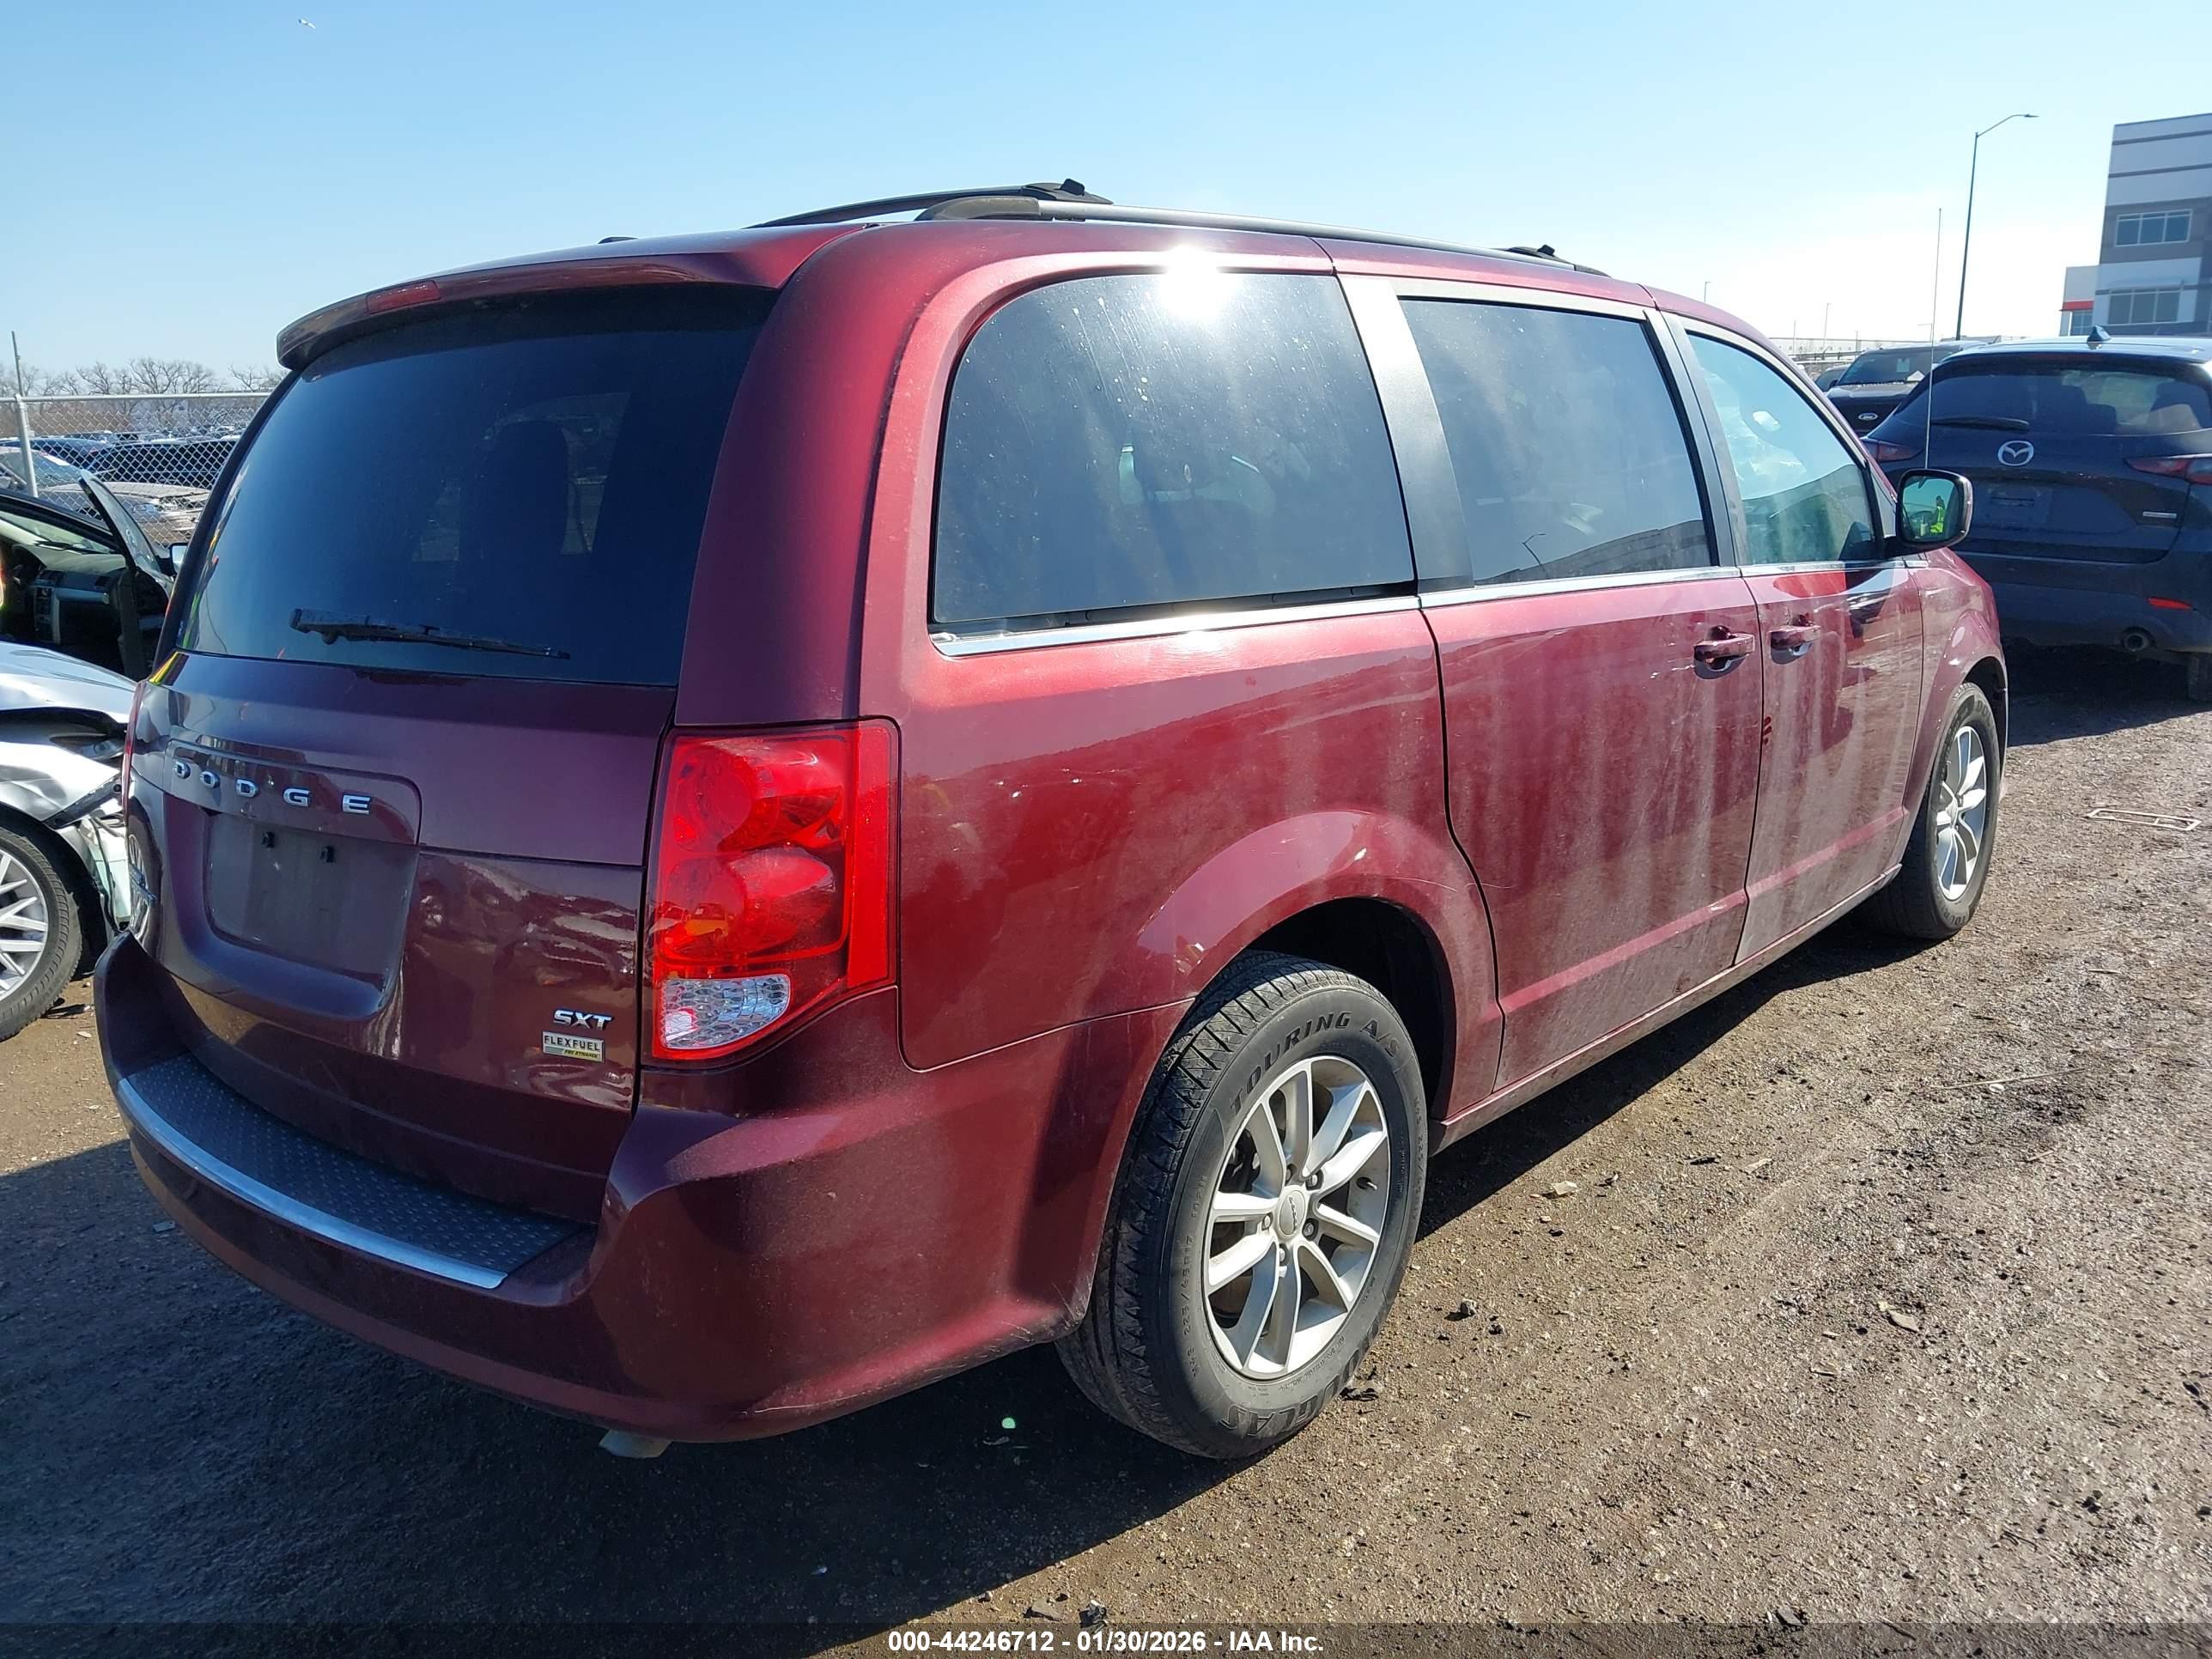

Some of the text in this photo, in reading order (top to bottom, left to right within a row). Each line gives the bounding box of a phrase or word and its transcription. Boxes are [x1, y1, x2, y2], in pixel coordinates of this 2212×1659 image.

[174, 760, 371, 815] DODGE
[553, 1009, 612, 1030] SXT
[1230, 1012, 1401, 1115] TOURING A/S
